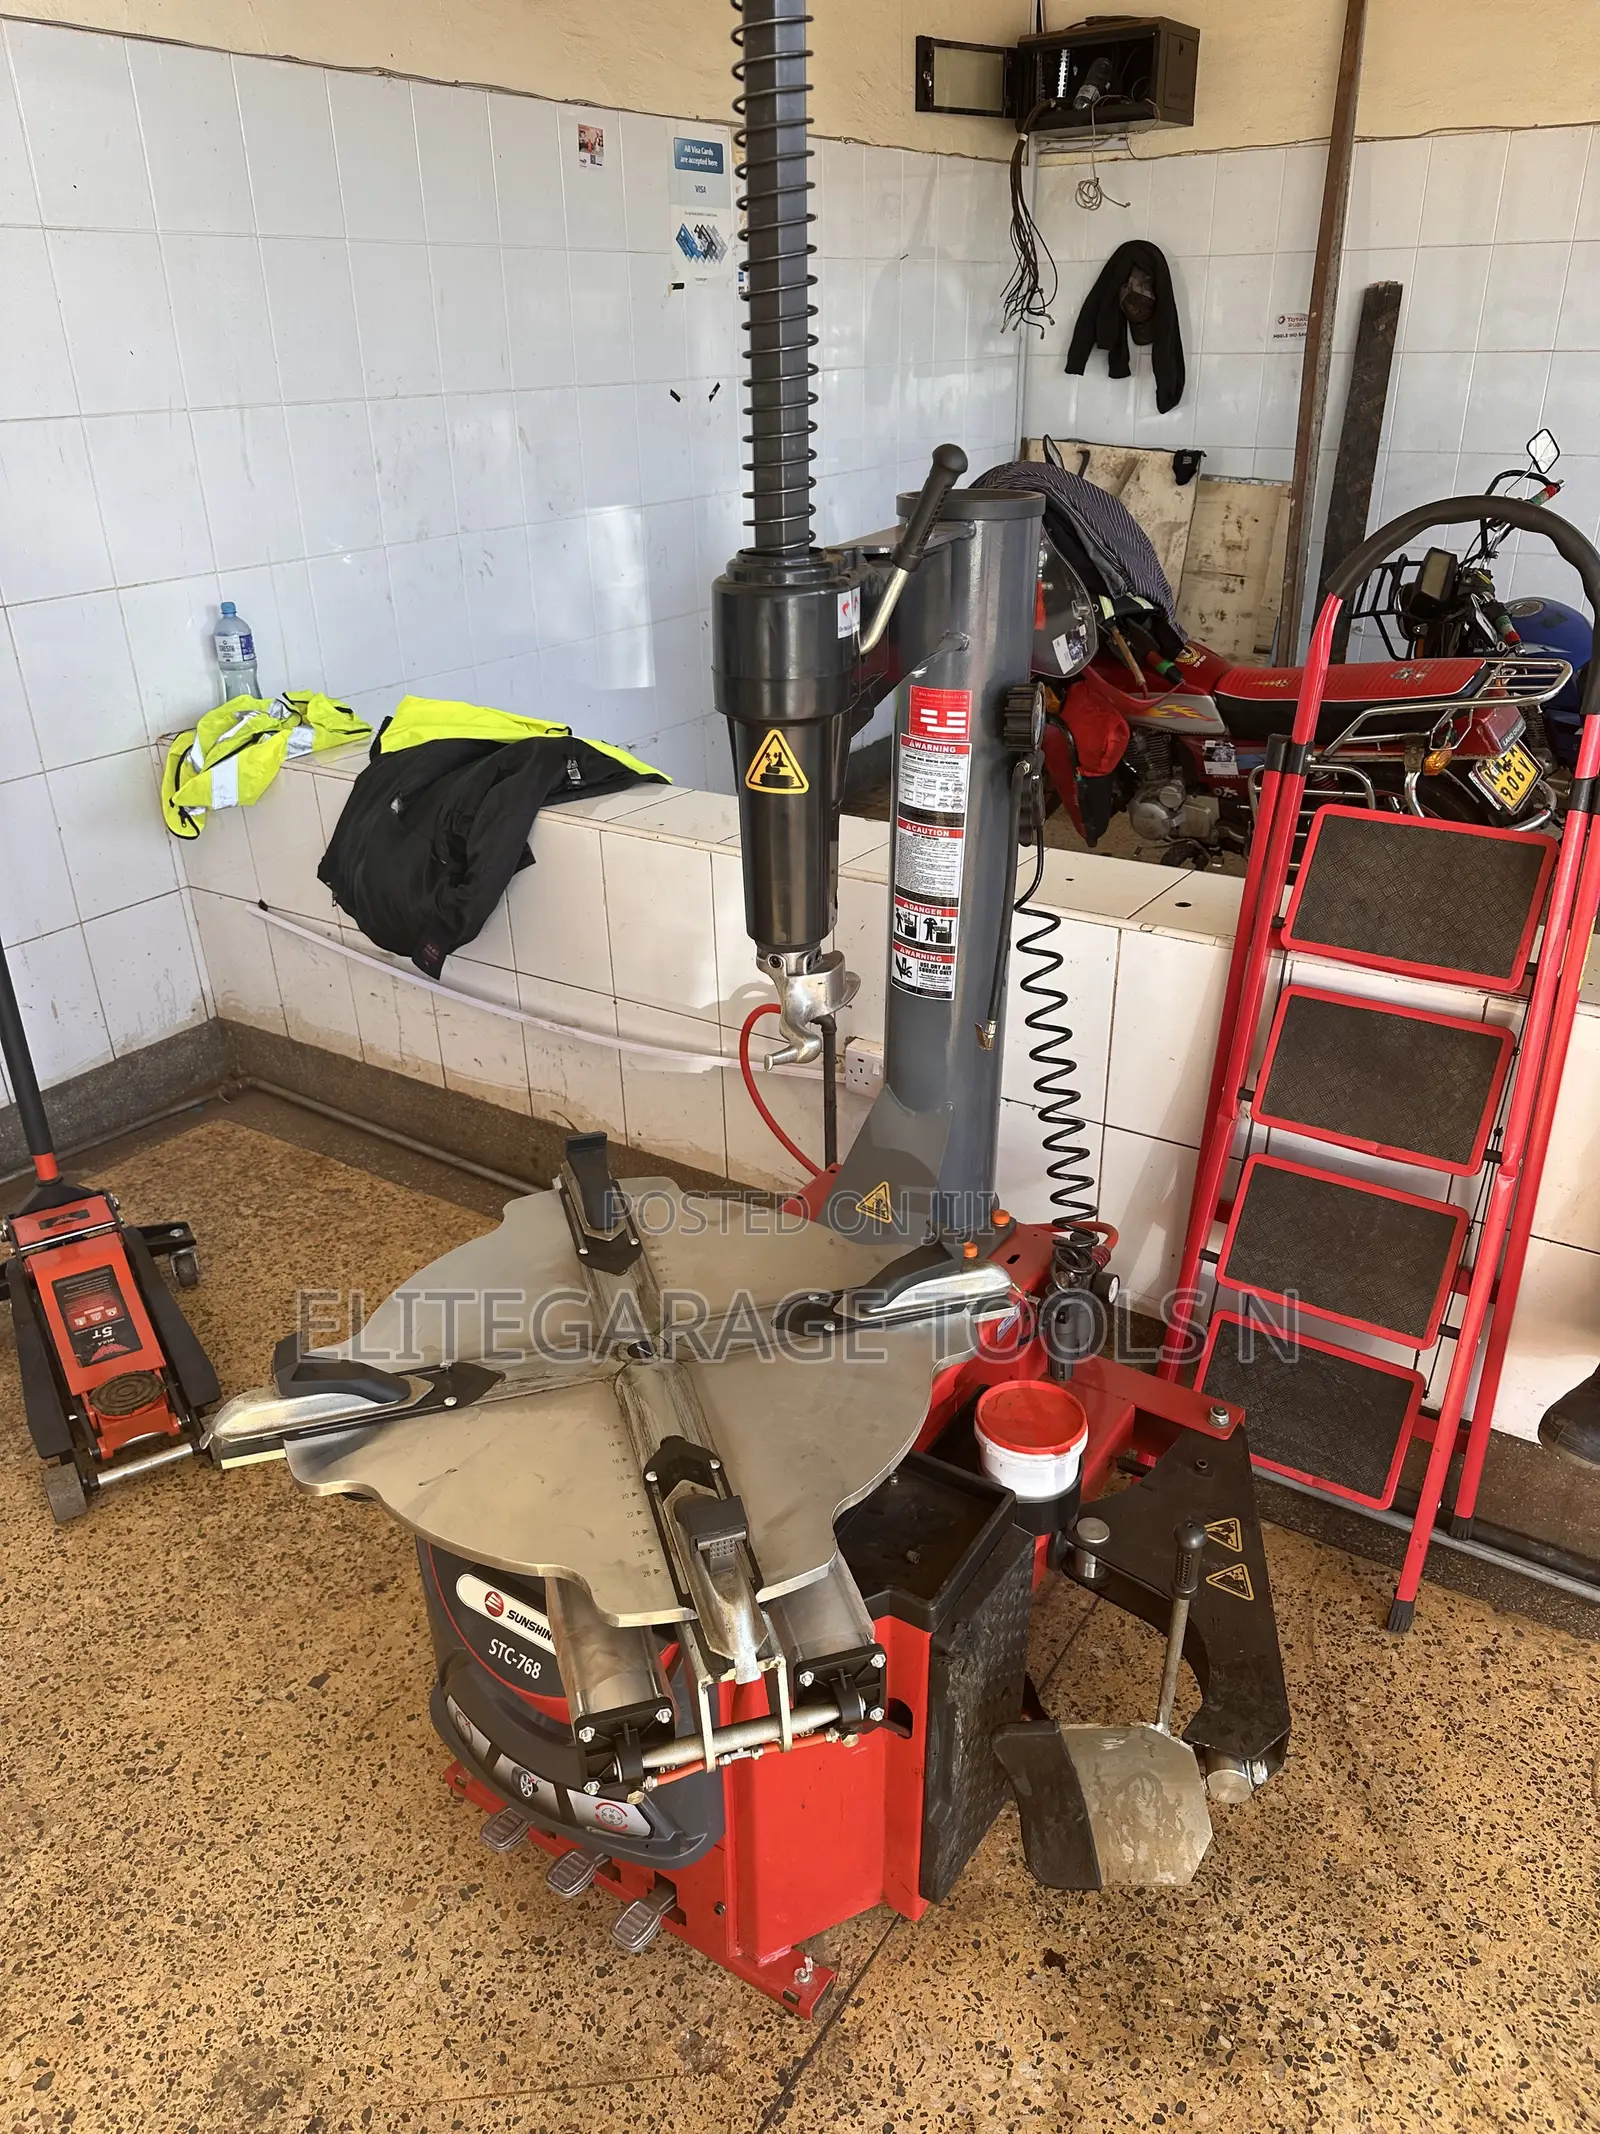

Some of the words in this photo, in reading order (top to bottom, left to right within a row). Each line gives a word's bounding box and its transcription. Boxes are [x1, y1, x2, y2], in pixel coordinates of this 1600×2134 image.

[691, 145, 701, 154] Visa
[701, 147, 714, 156] Cards
[689, 157, 707, 167] accepted
[708, 158, 718, 167] here
[694, 184, 707, 193] VISA
[914, 741, 957, 753] WARNING
[1500, 757, 1531, 801] 906V
[911, 825, 950, 837] CAUTION
[910, 904, 943, 916] DANGER
[904, 948, 942, 961] WARNING
[92, 1326, 113, 1339] 5T
[632, 1530, 640, 1538] 24
[488, 1638, 542, 1680] STC-768
